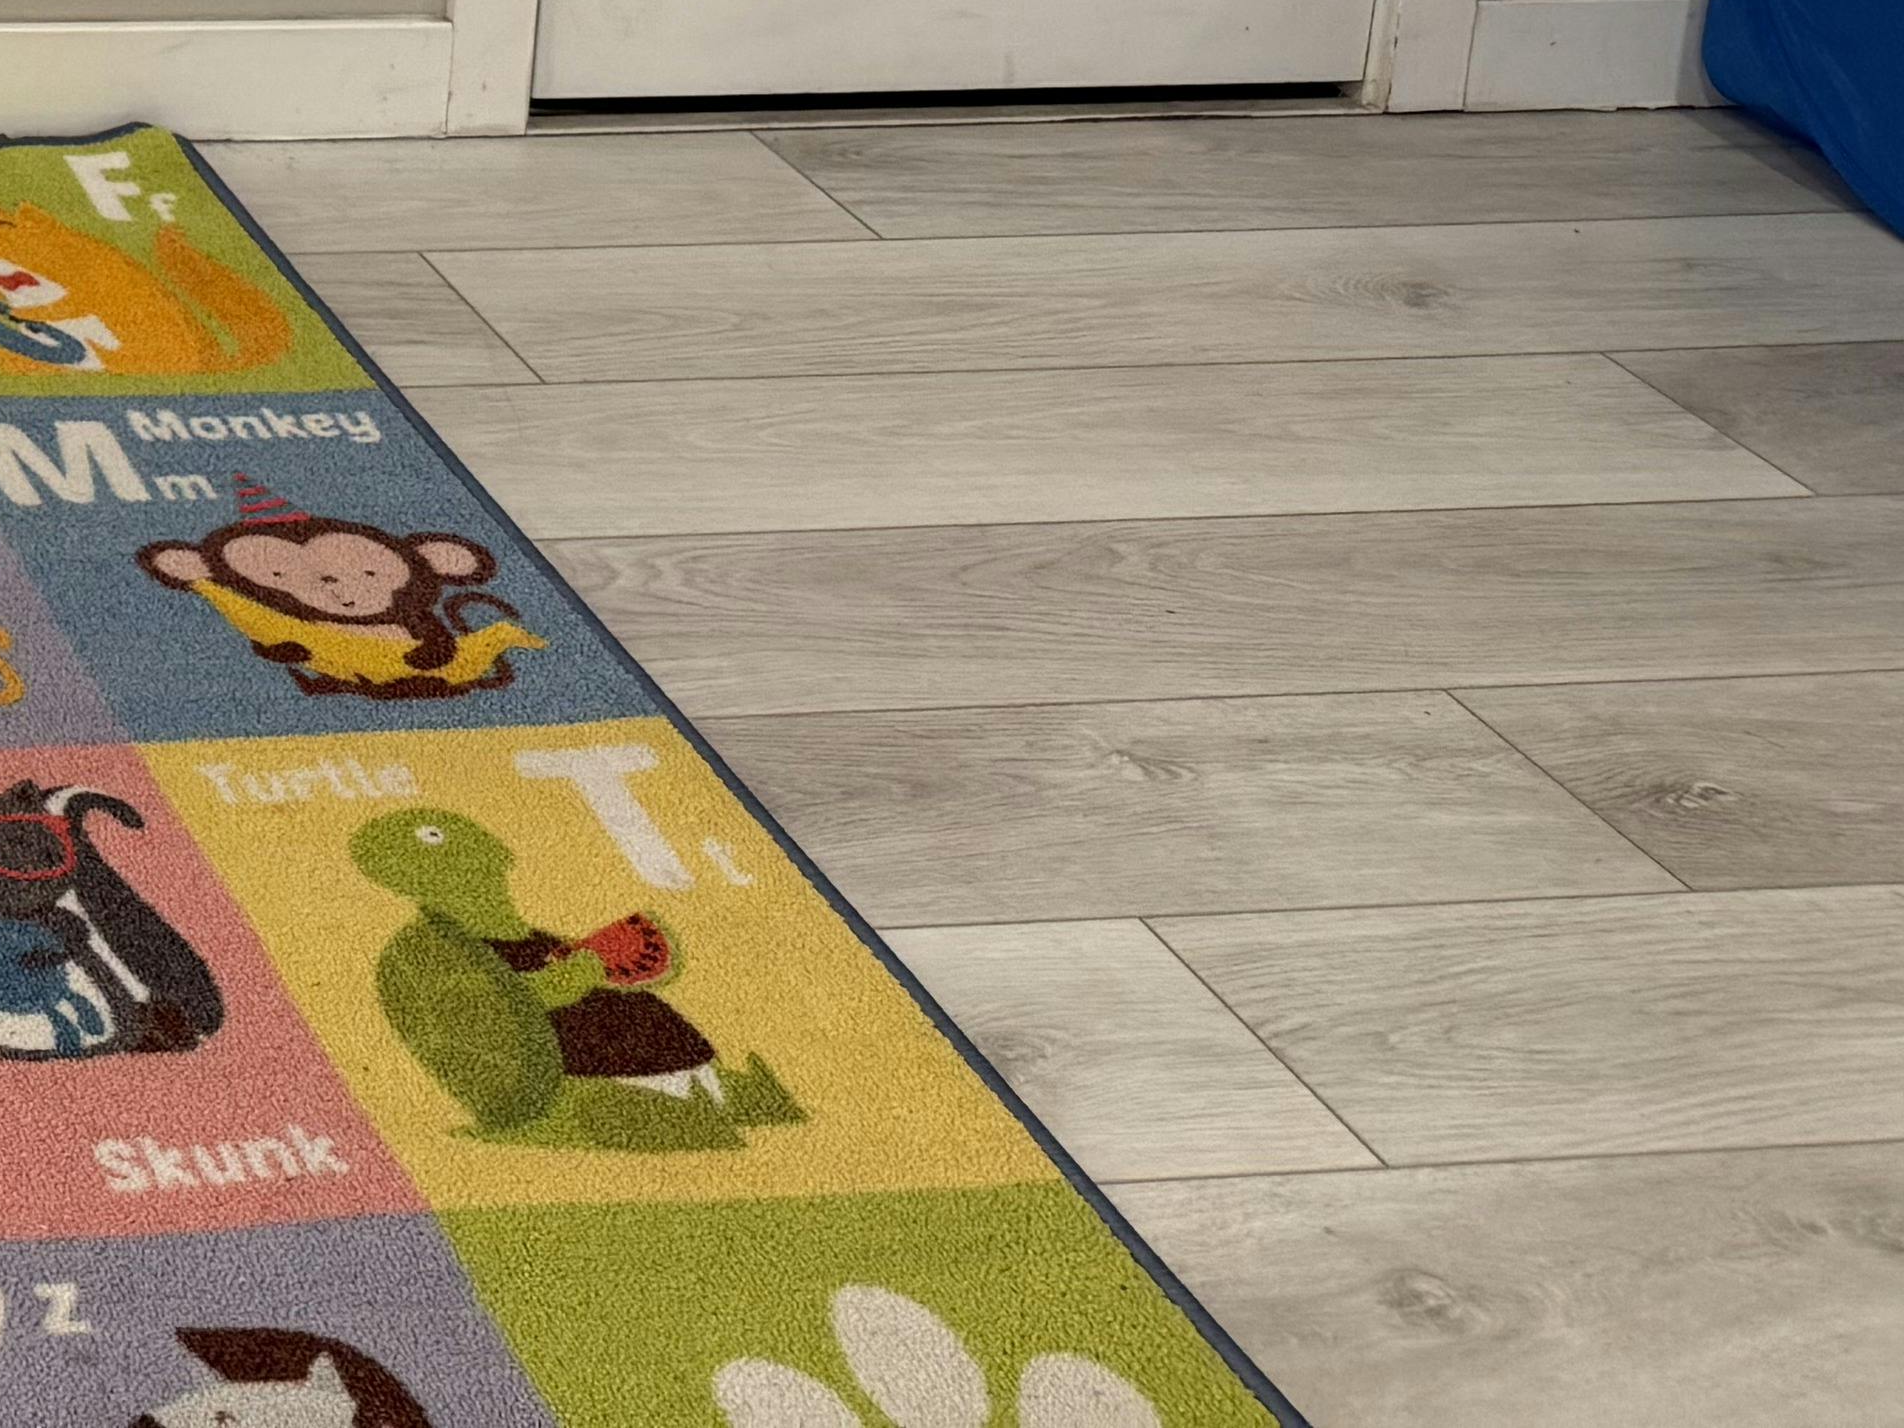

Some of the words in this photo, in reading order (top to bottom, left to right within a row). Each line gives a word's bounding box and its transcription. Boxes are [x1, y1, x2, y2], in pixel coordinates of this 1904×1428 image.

[130, 408, 381, 444] Monkey
[199, 760, 422, 803] Turtle
[97, 1127, 349, 1189] Skunk
